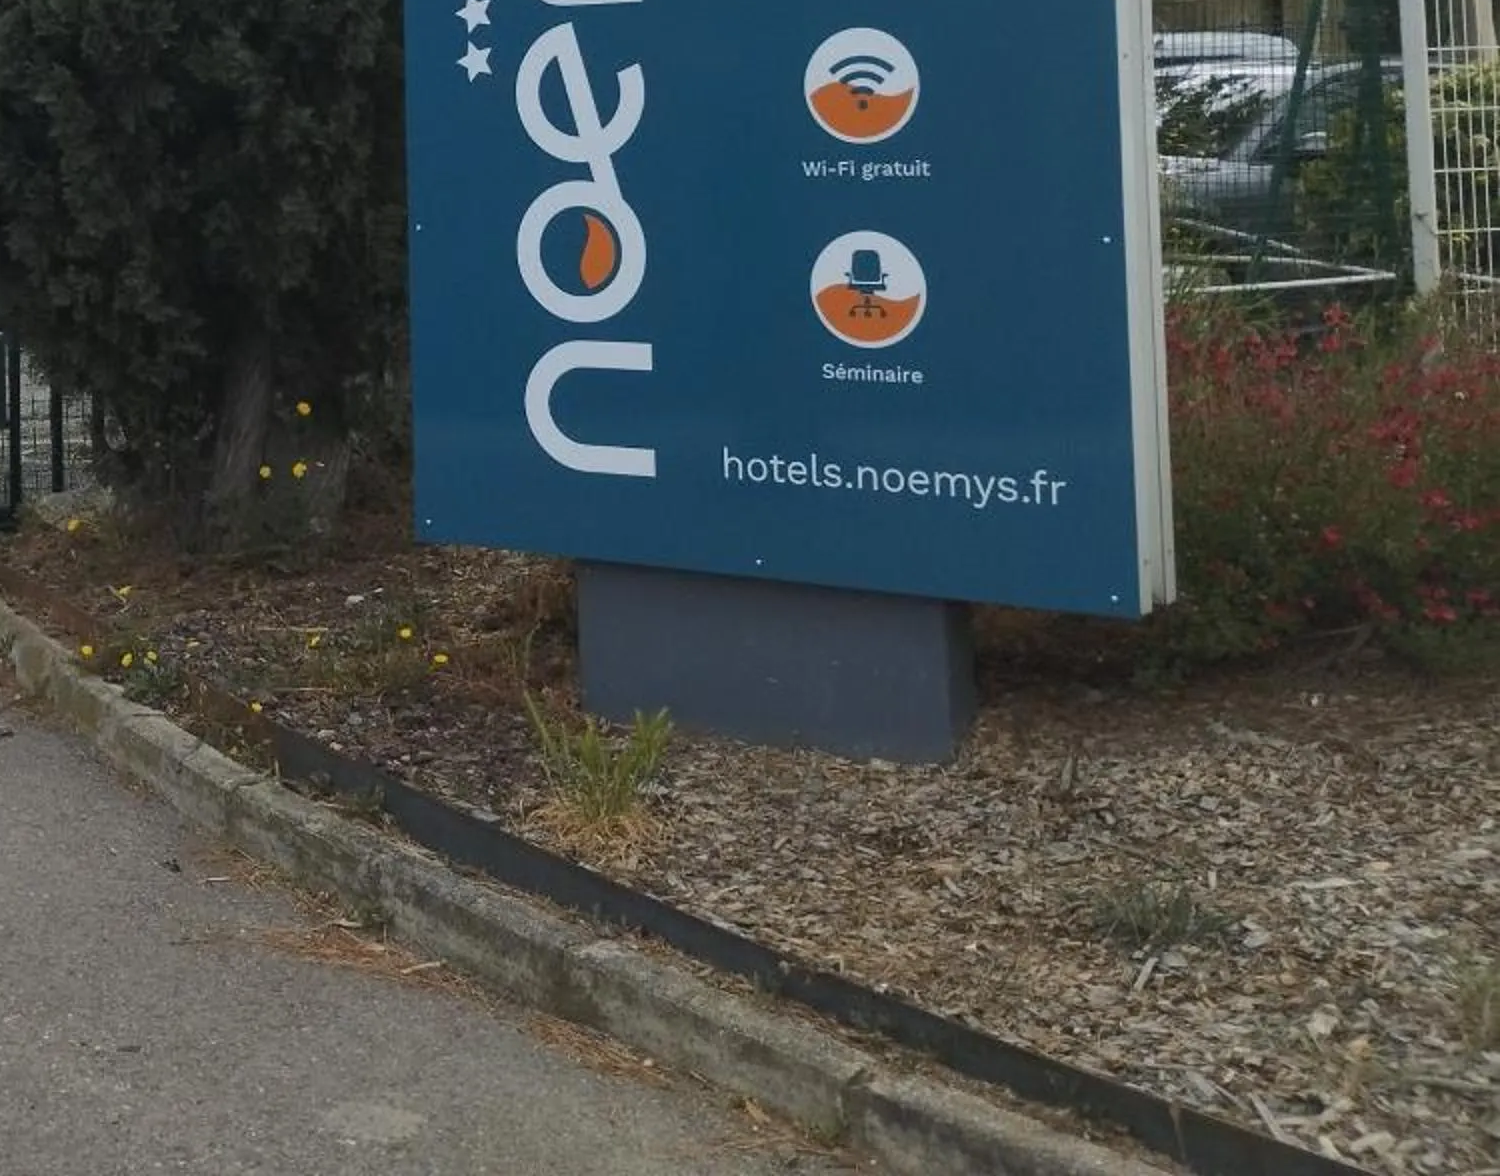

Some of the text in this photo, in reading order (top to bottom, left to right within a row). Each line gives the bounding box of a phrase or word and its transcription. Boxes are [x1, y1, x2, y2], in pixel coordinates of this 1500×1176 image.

[802, 159, 931, 181] Wi-Fi gratuit
[822, 362, 924, 385] Séminaire
[722, 446, 1068, 510] hotels.noemys.fr
